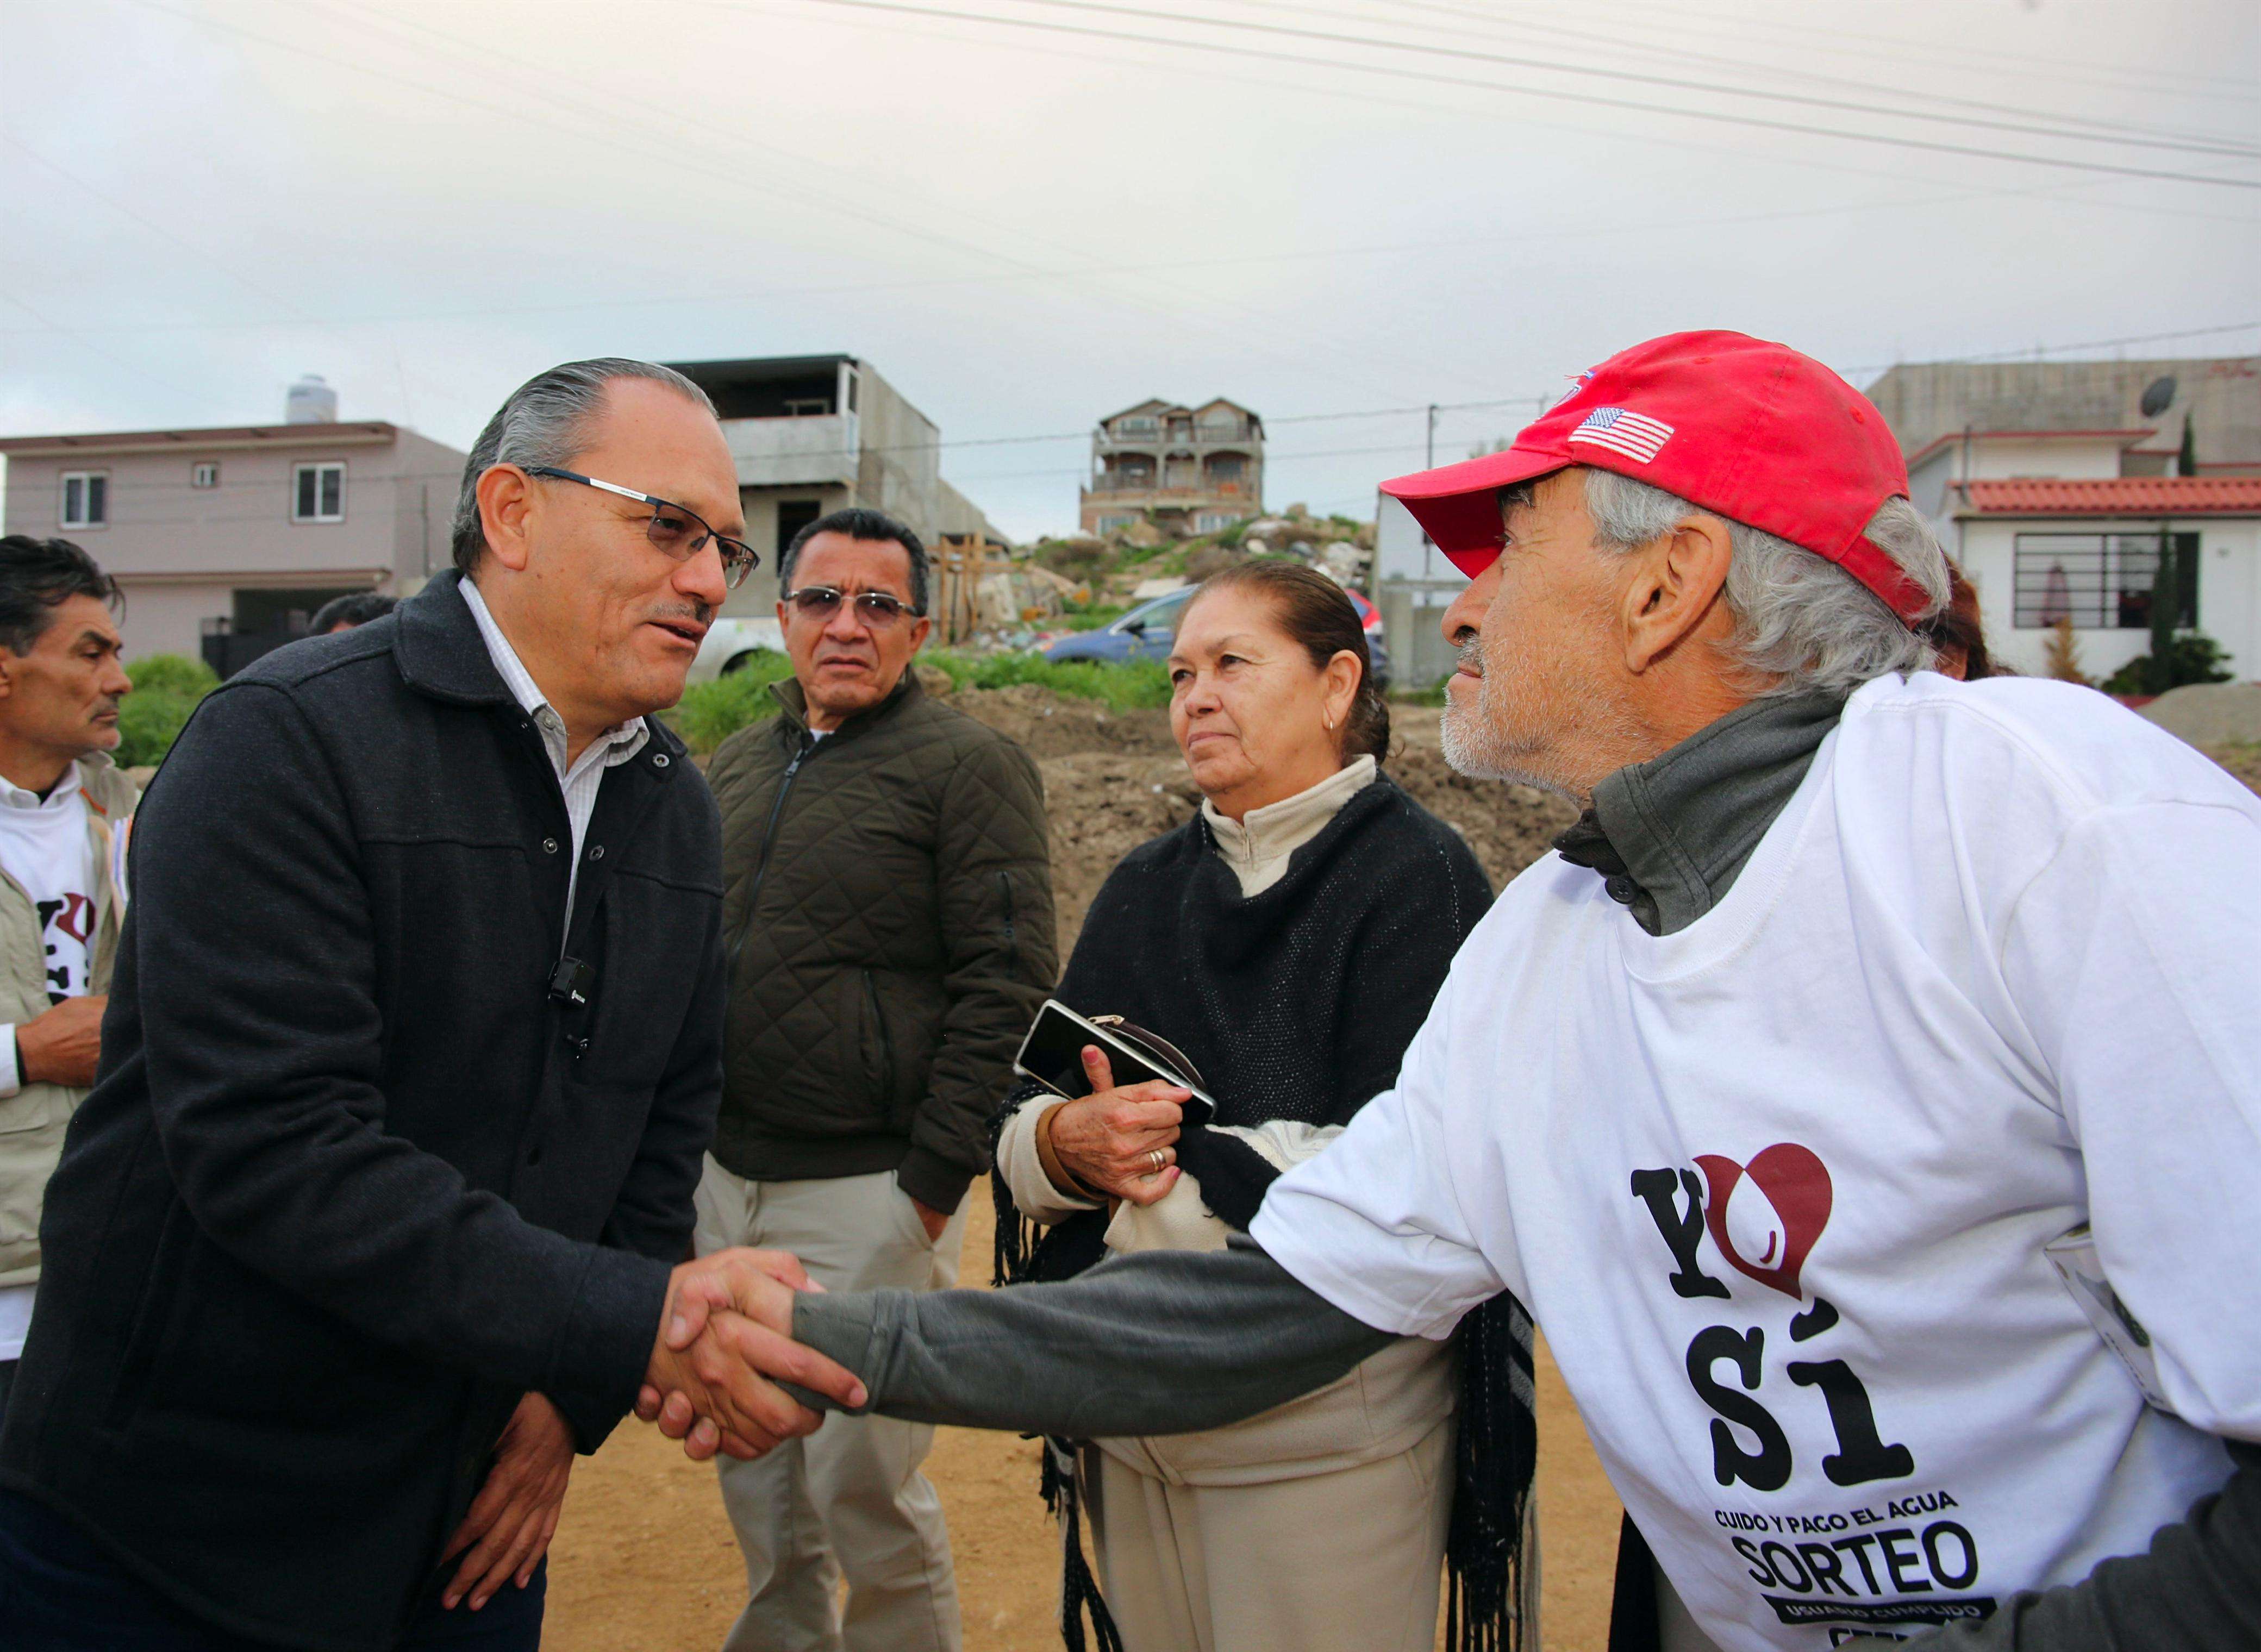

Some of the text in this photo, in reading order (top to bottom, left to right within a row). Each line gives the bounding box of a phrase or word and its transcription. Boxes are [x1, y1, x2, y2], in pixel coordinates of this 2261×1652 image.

[1715, 1490, 1959, 1533] CUIDO Y PAGO EL AGUA
[1731, 1520, 1978, 1596] SORTEO
